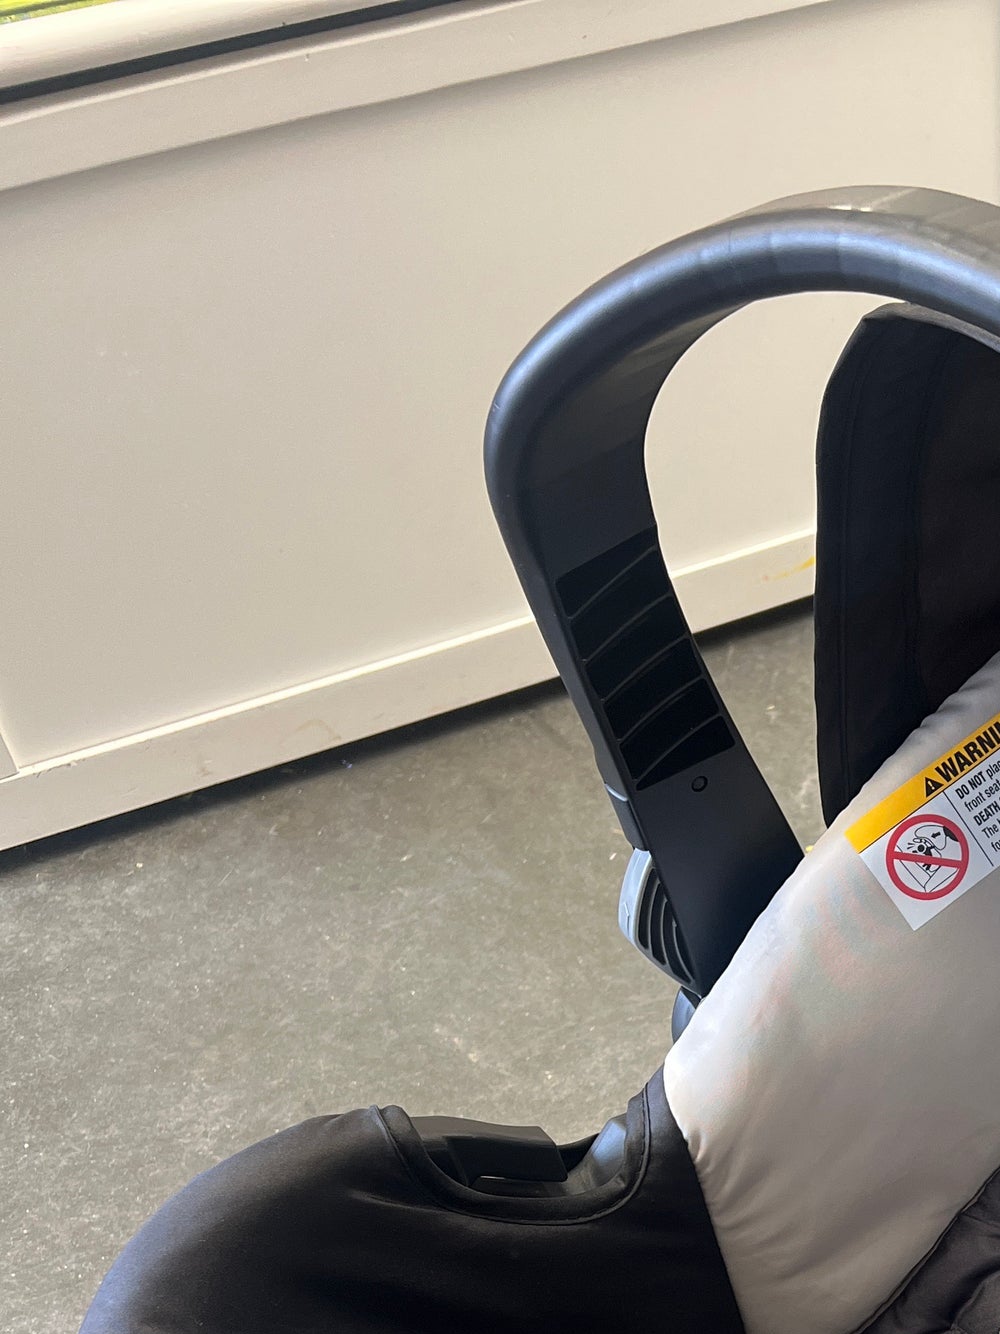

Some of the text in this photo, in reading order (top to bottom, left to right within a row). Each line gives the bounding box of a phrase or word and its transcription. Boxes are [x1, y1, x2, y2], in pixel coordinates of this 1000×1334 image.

[954, 783, 970, 800] DO
[967, 770, 987, 790] NOT
[963, 791, 987, 813] front
[973, 800, 1000, 827] DEATH
[981, 823, 1000, 839] The
